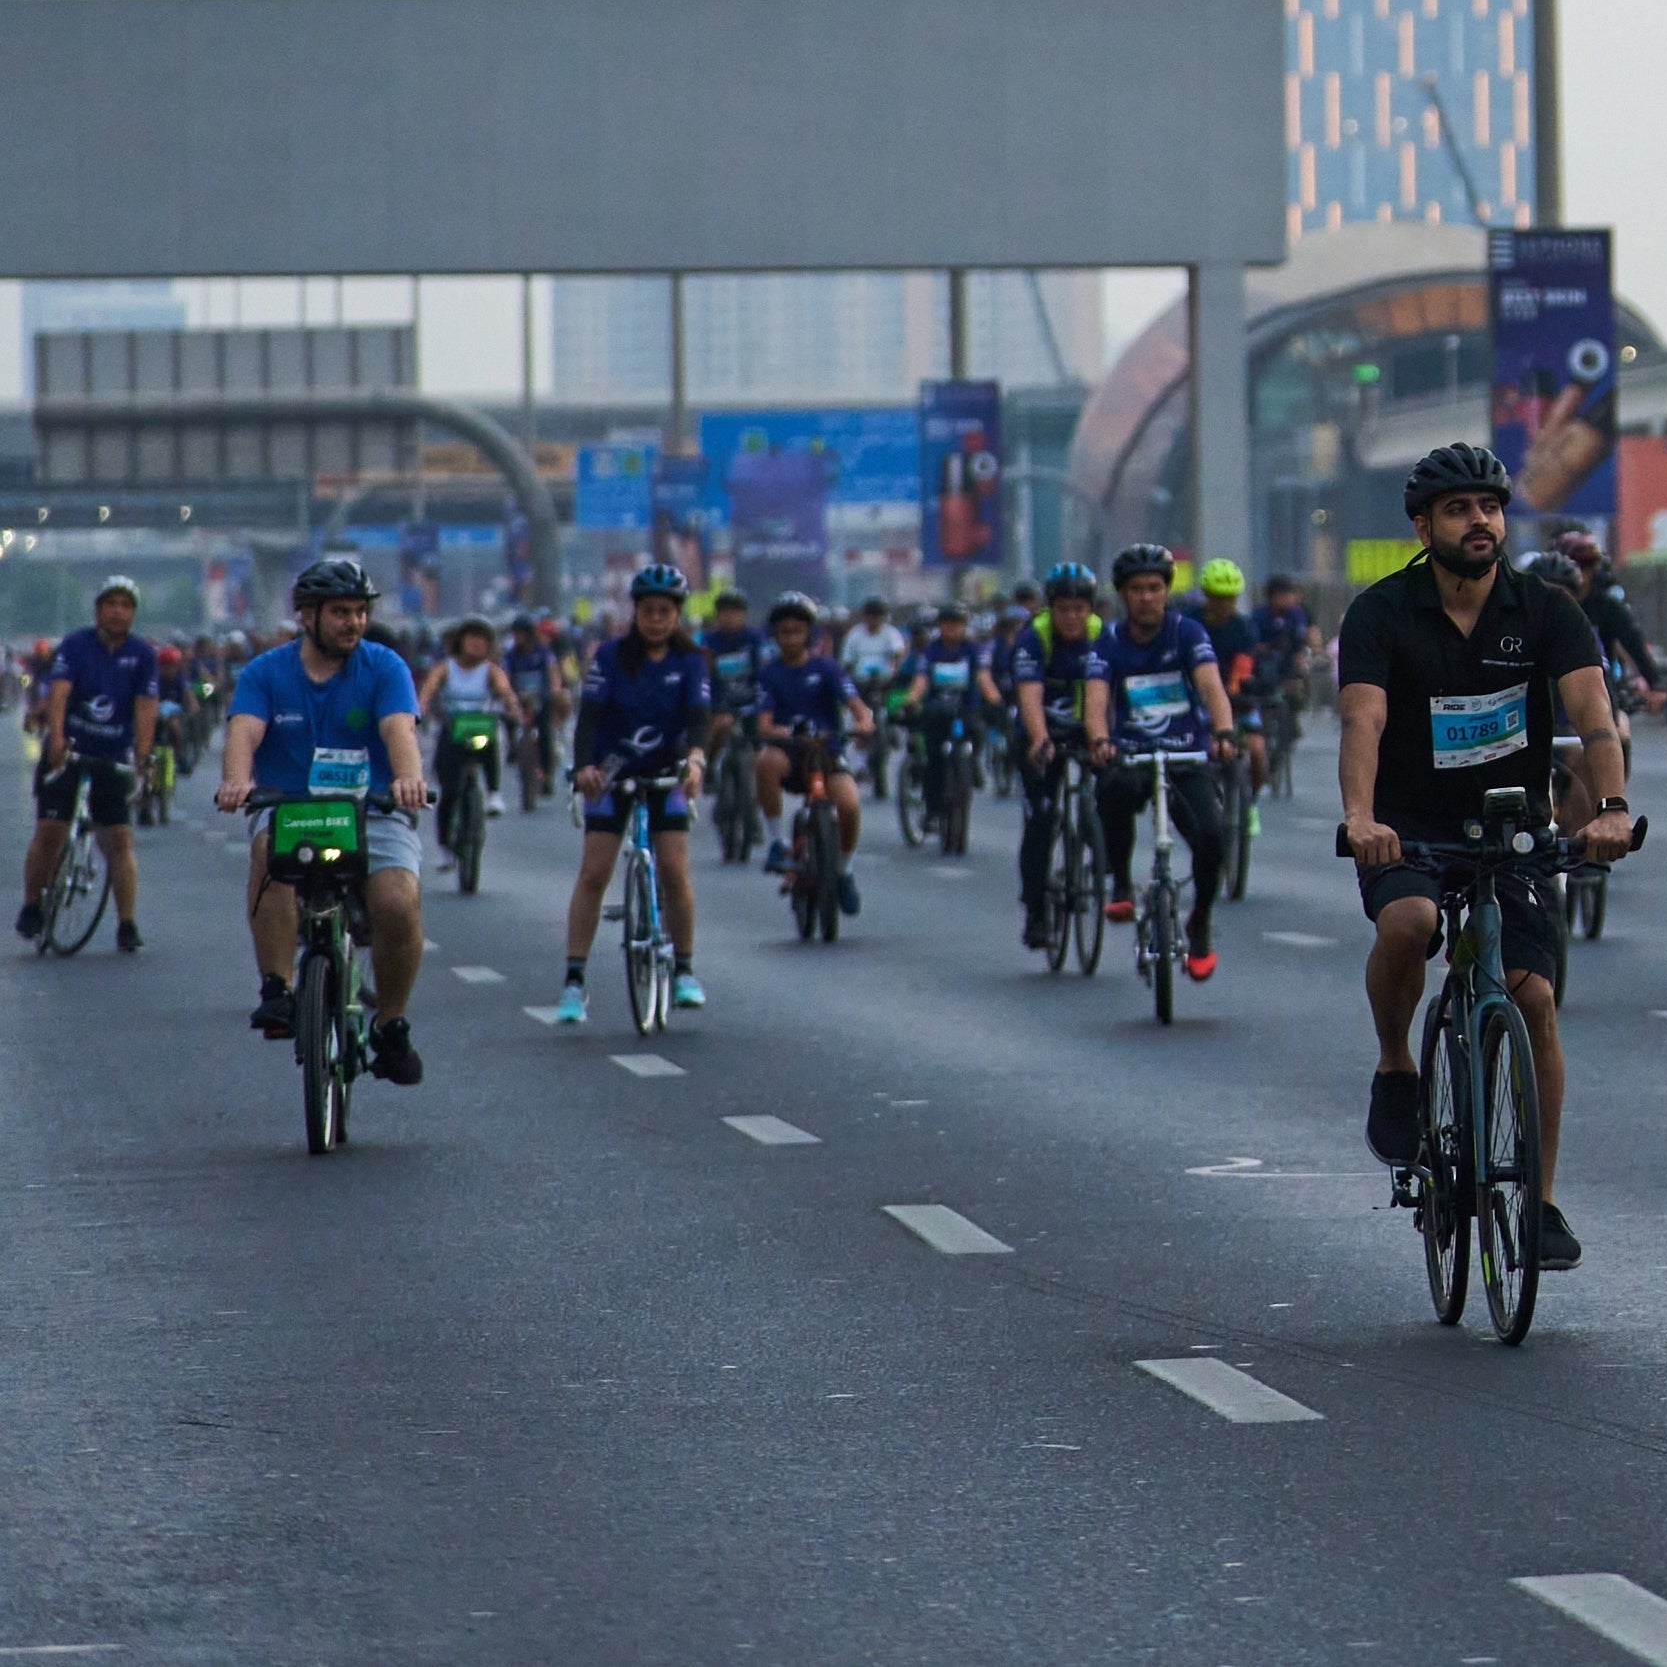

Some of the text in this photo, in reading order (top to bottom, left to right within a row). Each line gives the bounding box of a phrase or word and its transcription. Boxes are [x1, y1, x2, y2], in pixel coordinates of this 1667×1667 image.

[1500, 636, 1522, 653] GR
[1443, 703, 1466, 711] RIDE
[1446, 721, 1499, 742] 01789
[283, 814, 350, 828] Careem BIKE
